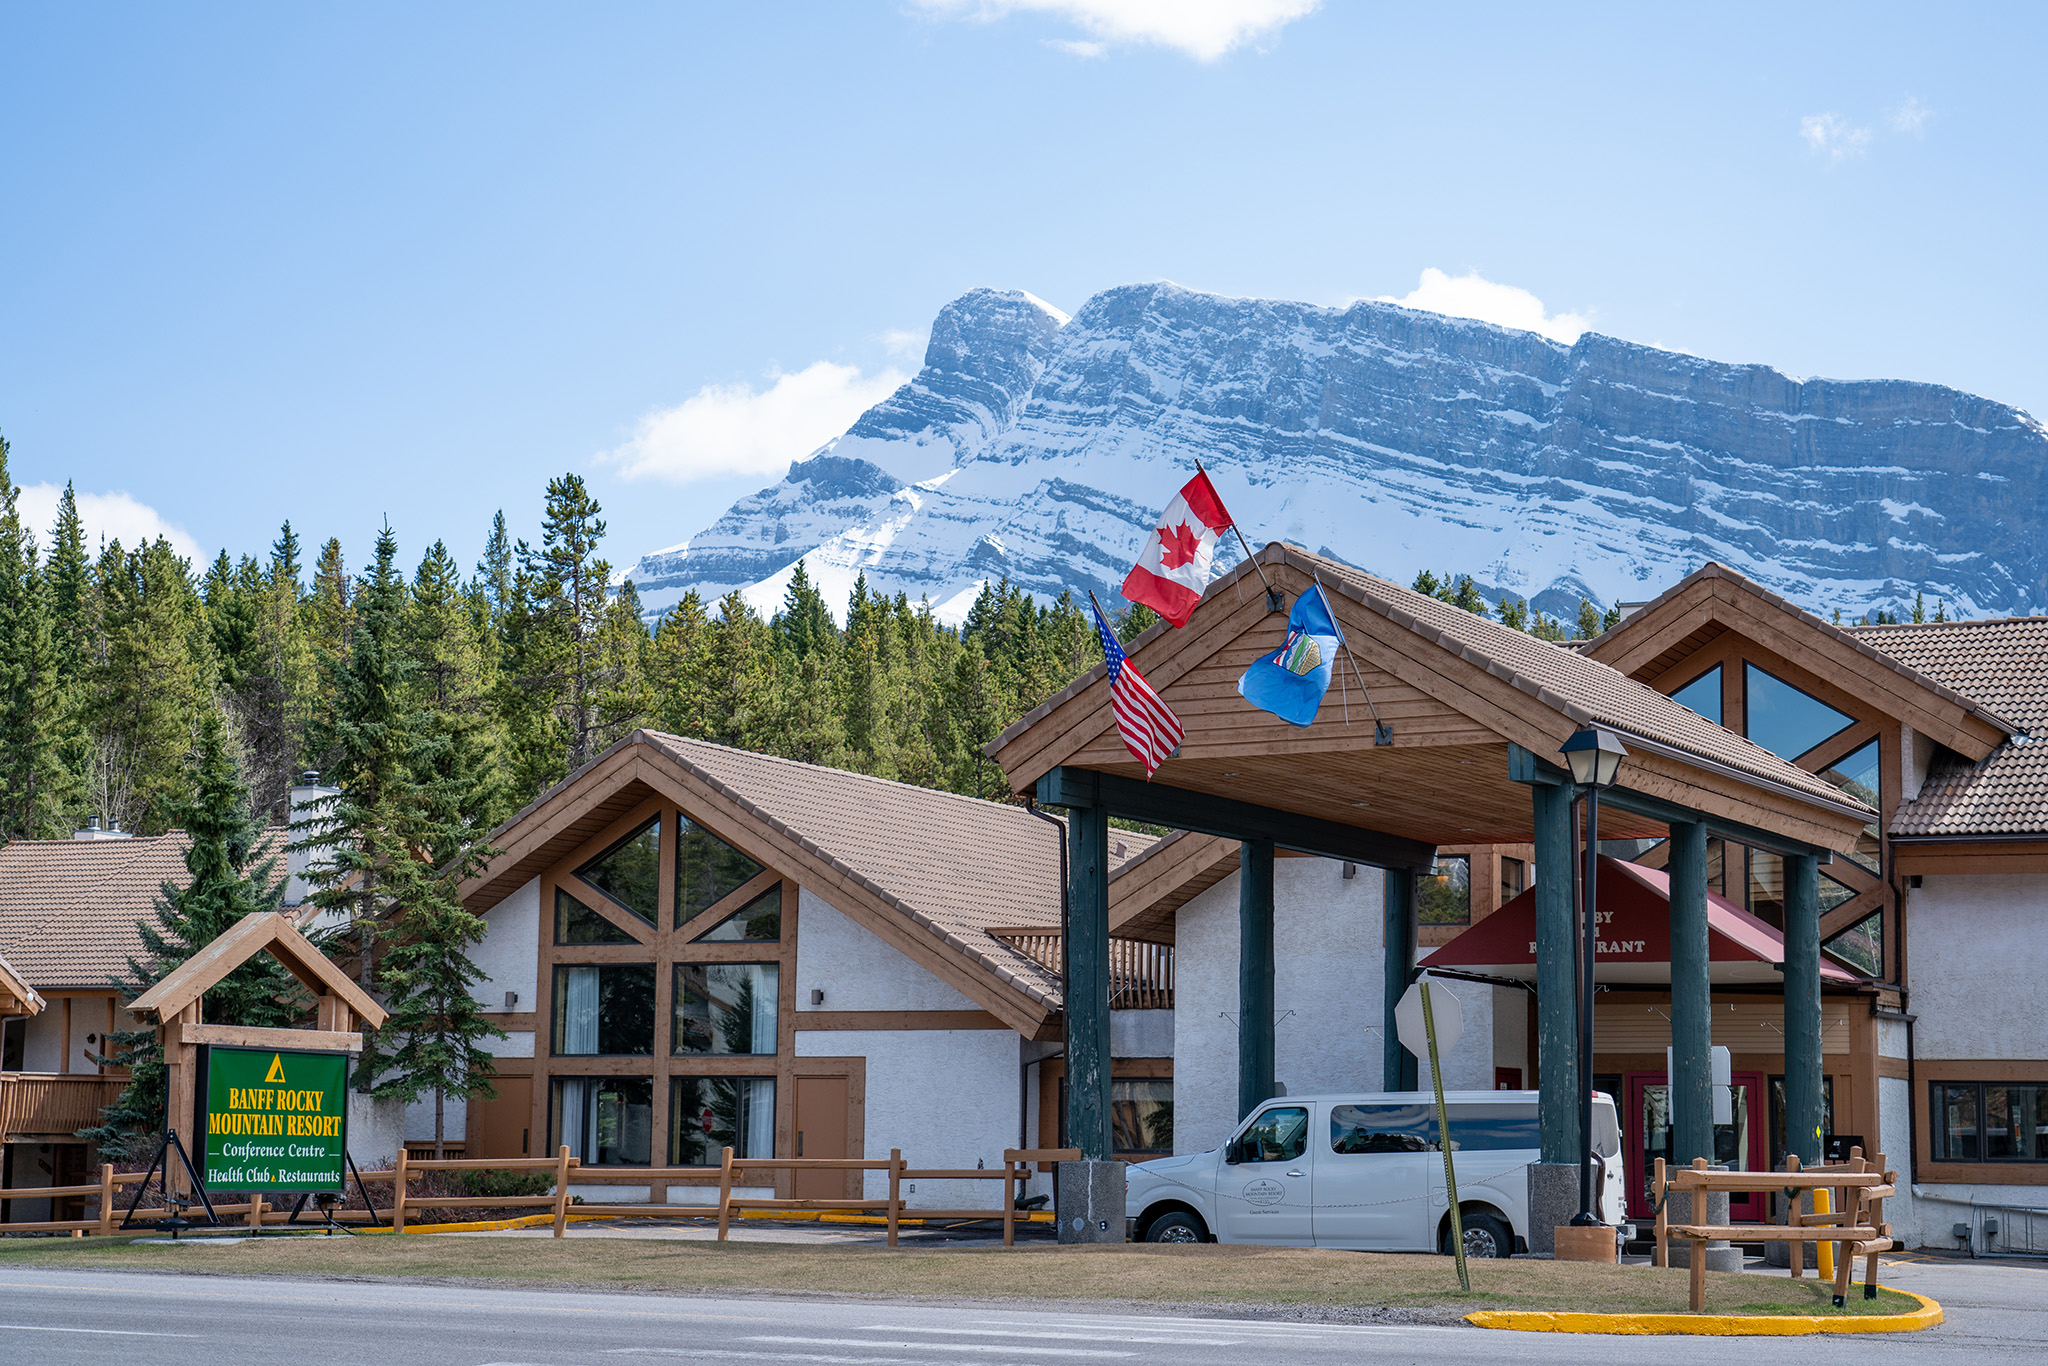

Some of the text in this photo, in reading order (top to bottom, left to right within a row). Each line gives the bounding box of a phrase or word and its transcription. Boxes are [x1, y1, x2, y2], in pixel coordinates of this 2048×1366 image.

[229, 1088, 324, 1112] BANFF ROCKY
[208, 1113, 341, 1137] MOUNTAIN RESORT
[223, 1141, 326, 1163] Conference Centre
[208, 1166, 340, 1183] Health Club Restaurants
